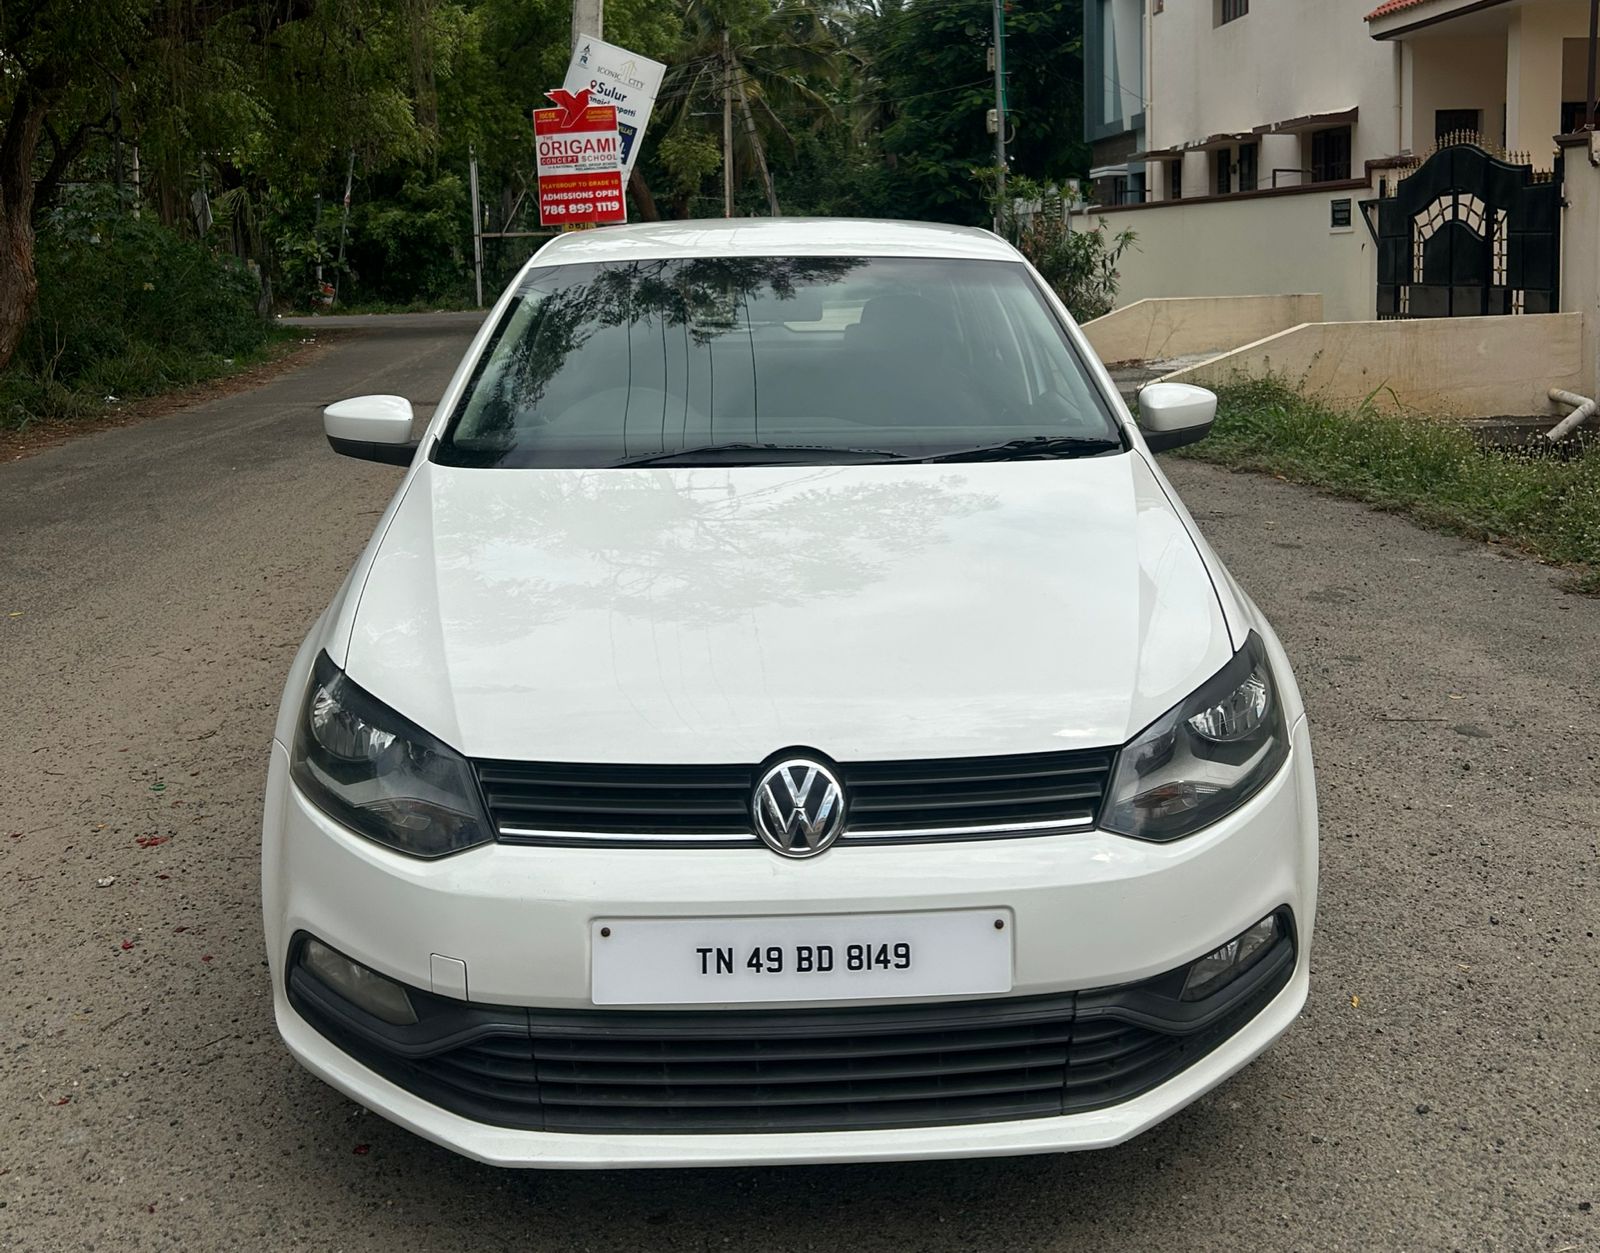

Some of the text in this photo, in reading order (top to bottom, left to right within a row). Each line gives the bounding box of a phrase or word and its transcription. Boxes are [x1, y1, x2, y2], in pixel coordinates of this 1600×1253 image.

[597, 66, 621, 80] ICONIC
[628, 78, 645, 89] CITY
[597, 82, 627, 102] Sulur
[540, 138, 616, 156] ORIGAMI
[541, 154, 617, 165] CONCEPT SCHOOL
[541, 182, 577, 190] PLAYGROUP
[542, 189, 619, 201] ADMISSIONS OPEN
[543, 201, 620, 215] 786 899 1119
[697, 942, 911, 974] TN 49 BD 8149
